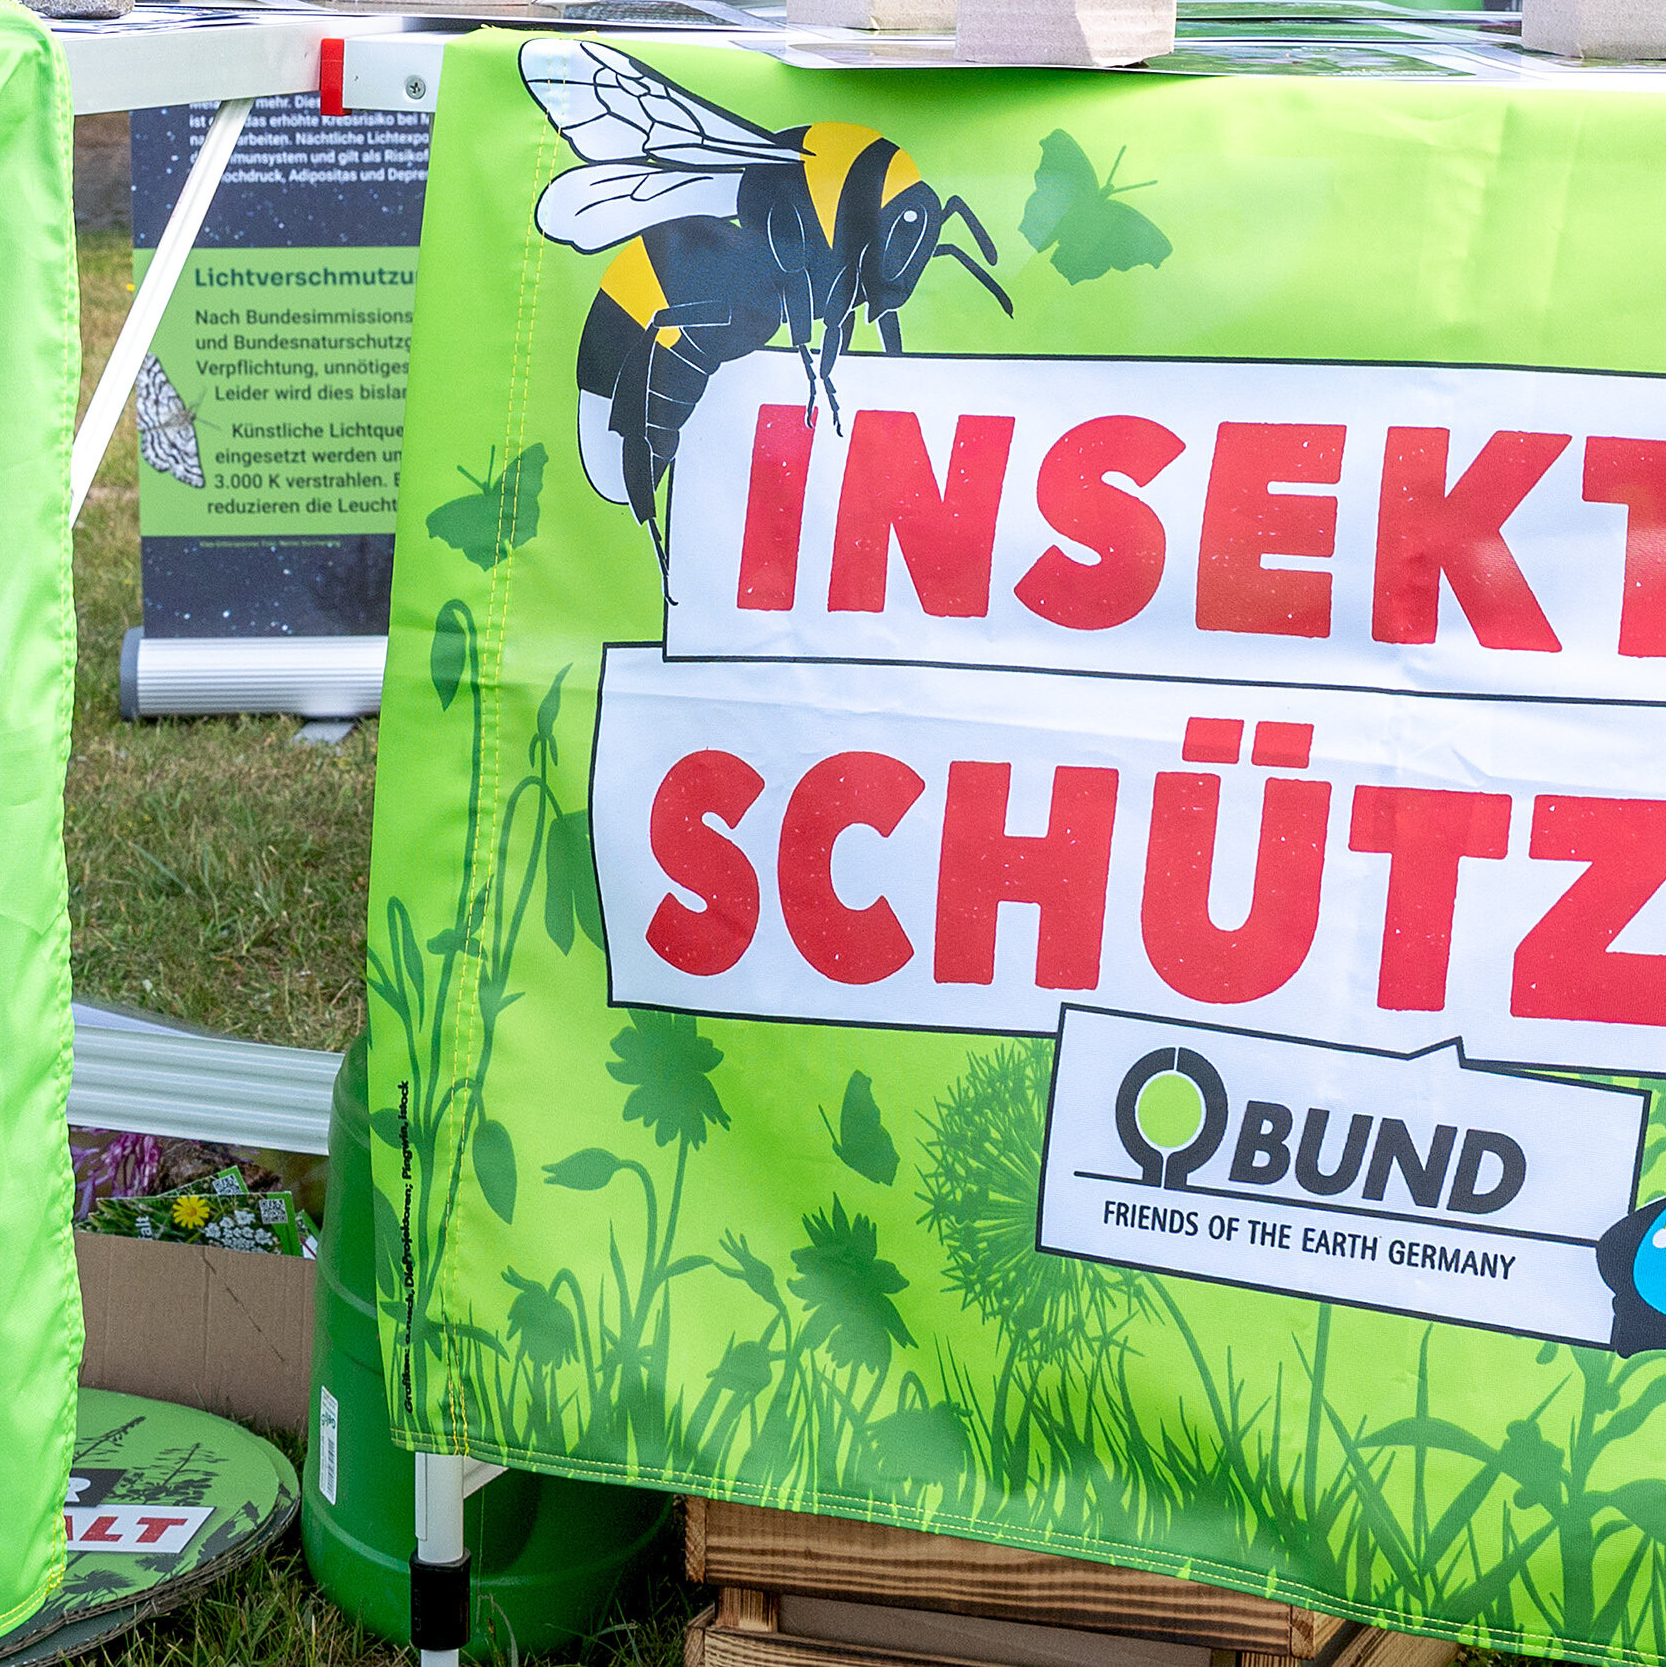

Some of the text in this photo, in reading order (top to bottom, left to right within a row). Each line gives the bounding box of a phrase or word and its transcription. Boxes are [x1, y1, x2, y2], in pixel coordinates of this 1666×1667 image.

[189, 114, 206, 128] ist
[269, 113, 319, 128] erhöhte
[397, 112, 419, 126] bei
[295, 131, 365, 146] Nächtliche
[310, 149, 335, 164] und
[361, 148, 382, 163] als
[288, 167, 358, 184] Adipositas
[359, 167, 385, 182] und
[195, 309, 413, 324] Nach Bundesimmissions
[196, 335, 228, 350] und
[196, 360, 318, 378] Verpflichtung,
[215, 385, 268, 401] Leider
[275, 385, 312, 401] wird
[317, 385, 353, 401] dies
[232, 422, 324, 438] Künstliche
[215, 448, 307, 467] eingesetzt
[312, 447, 376, 463] werden
[214, 473, 262, 489] 3.000
[269, 473, 281, 488] K
[286, 472, 388, 489] verstrahlen.
[208, 498, 300, 514] reduzieren
[306, 498, 333, 513] die
[1228, 1100, 1527, 1215] BUND
[1103, 1200, 1516, 1280] FRIENDS OF THE EARTH GERMANY
